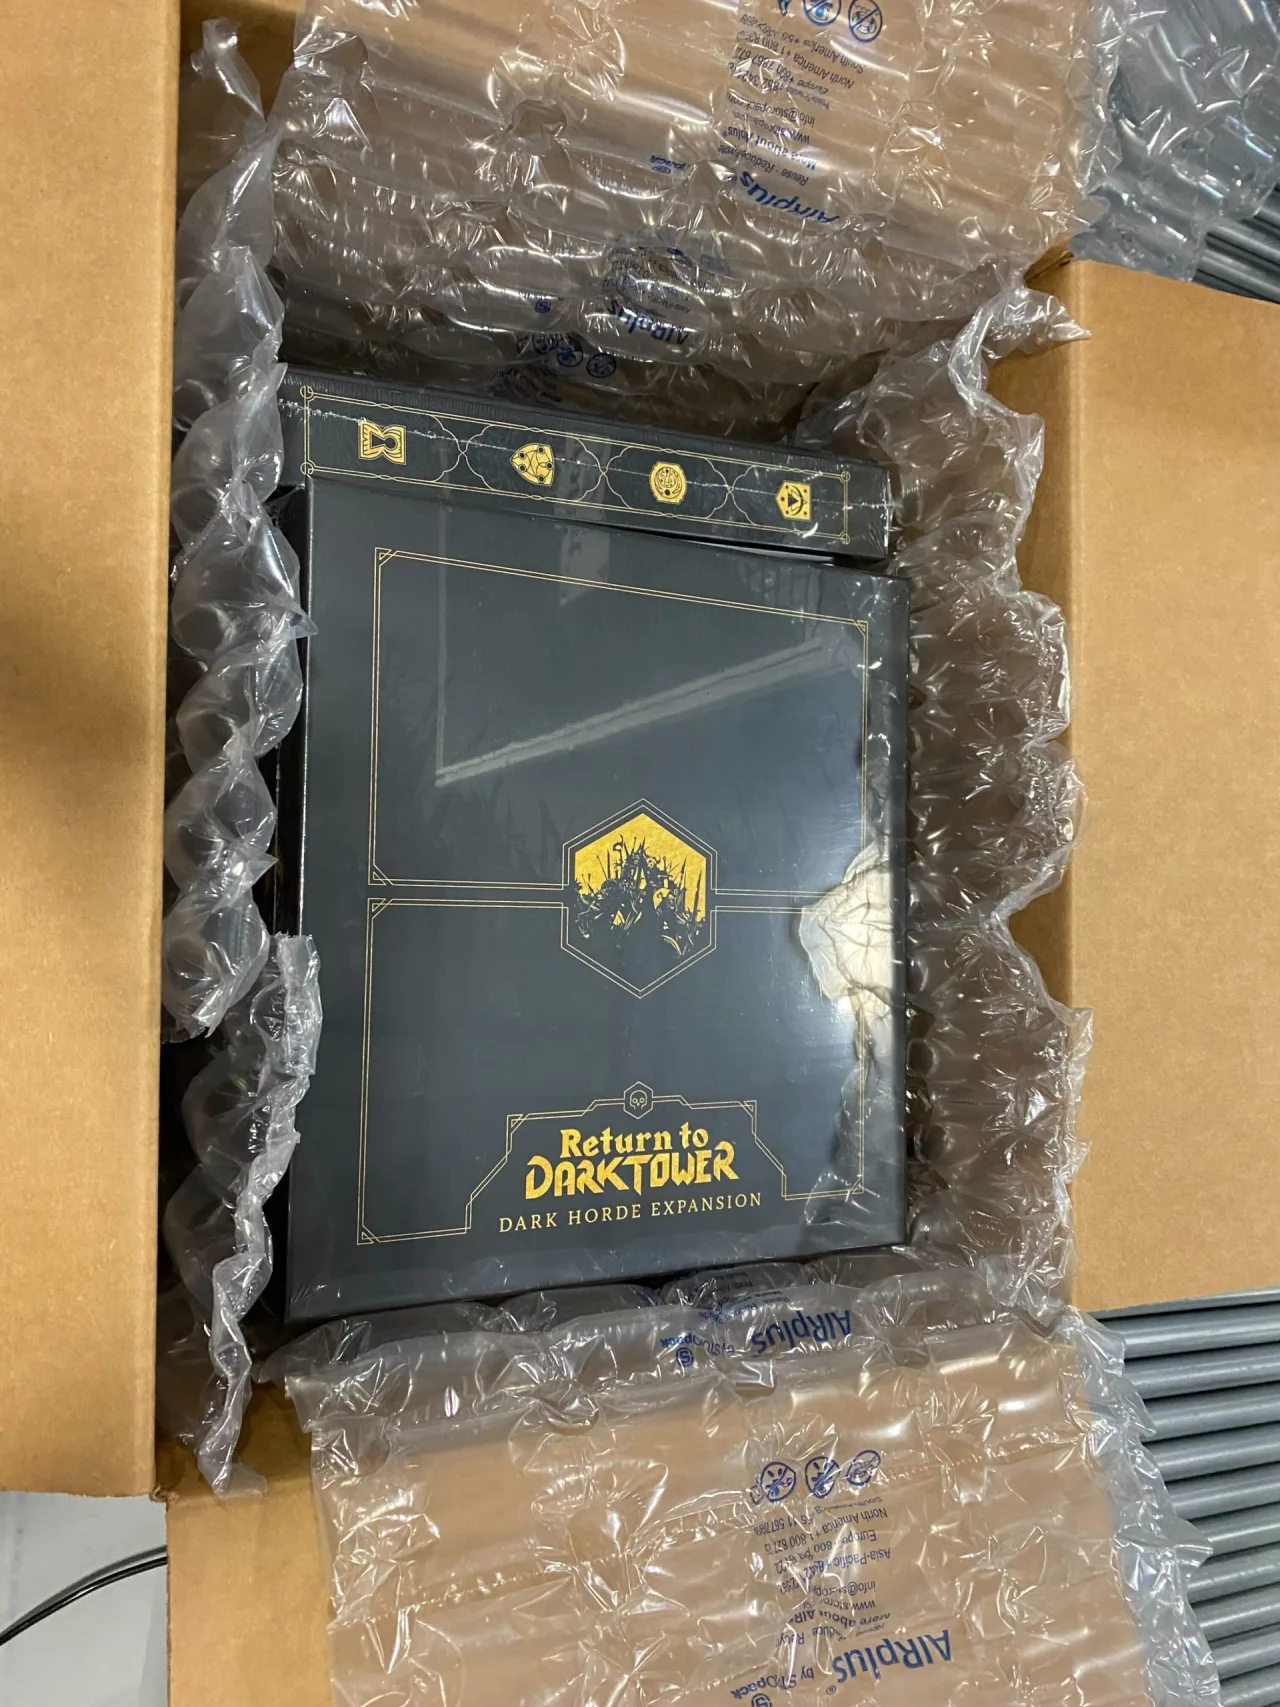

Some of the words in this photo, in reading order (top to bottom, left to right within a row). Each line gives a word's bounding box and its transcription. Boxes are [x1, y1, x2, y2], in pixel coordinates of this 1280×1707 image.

[803, 39, 841, 64] America
[791, 52, 830, 79] America
[797, 79, 829, 95] Europe
[830, 72, 855, 89] North
[754, 135, 788, 157] about
[791, 151, 817, 170] More
[781, 168, 809, 186] Reuse
[560, 1126, 672, 1158] Return
[678, 1121, 709, 1149] to
[499, 1212, 557, 1233] DARK
[568, 1203, 641, 1225] HORDE
[651, 1192, 762, 1217] EXPANSION
[750, 1310, 852, 1354] AIRplus
[821, 1513, 859, 1534] America
[861, 1507, 888, 1523] North
[789, 1532, 806, 1548] 800
[841, 1528, 877, 1545] Europe
[833, 1547, 891, 1569] Asia-Pacific
[818, 1609, 856, 1628] about
[860, 1612, 891, 1626] More
[800, 1666, 814, 1681] by
